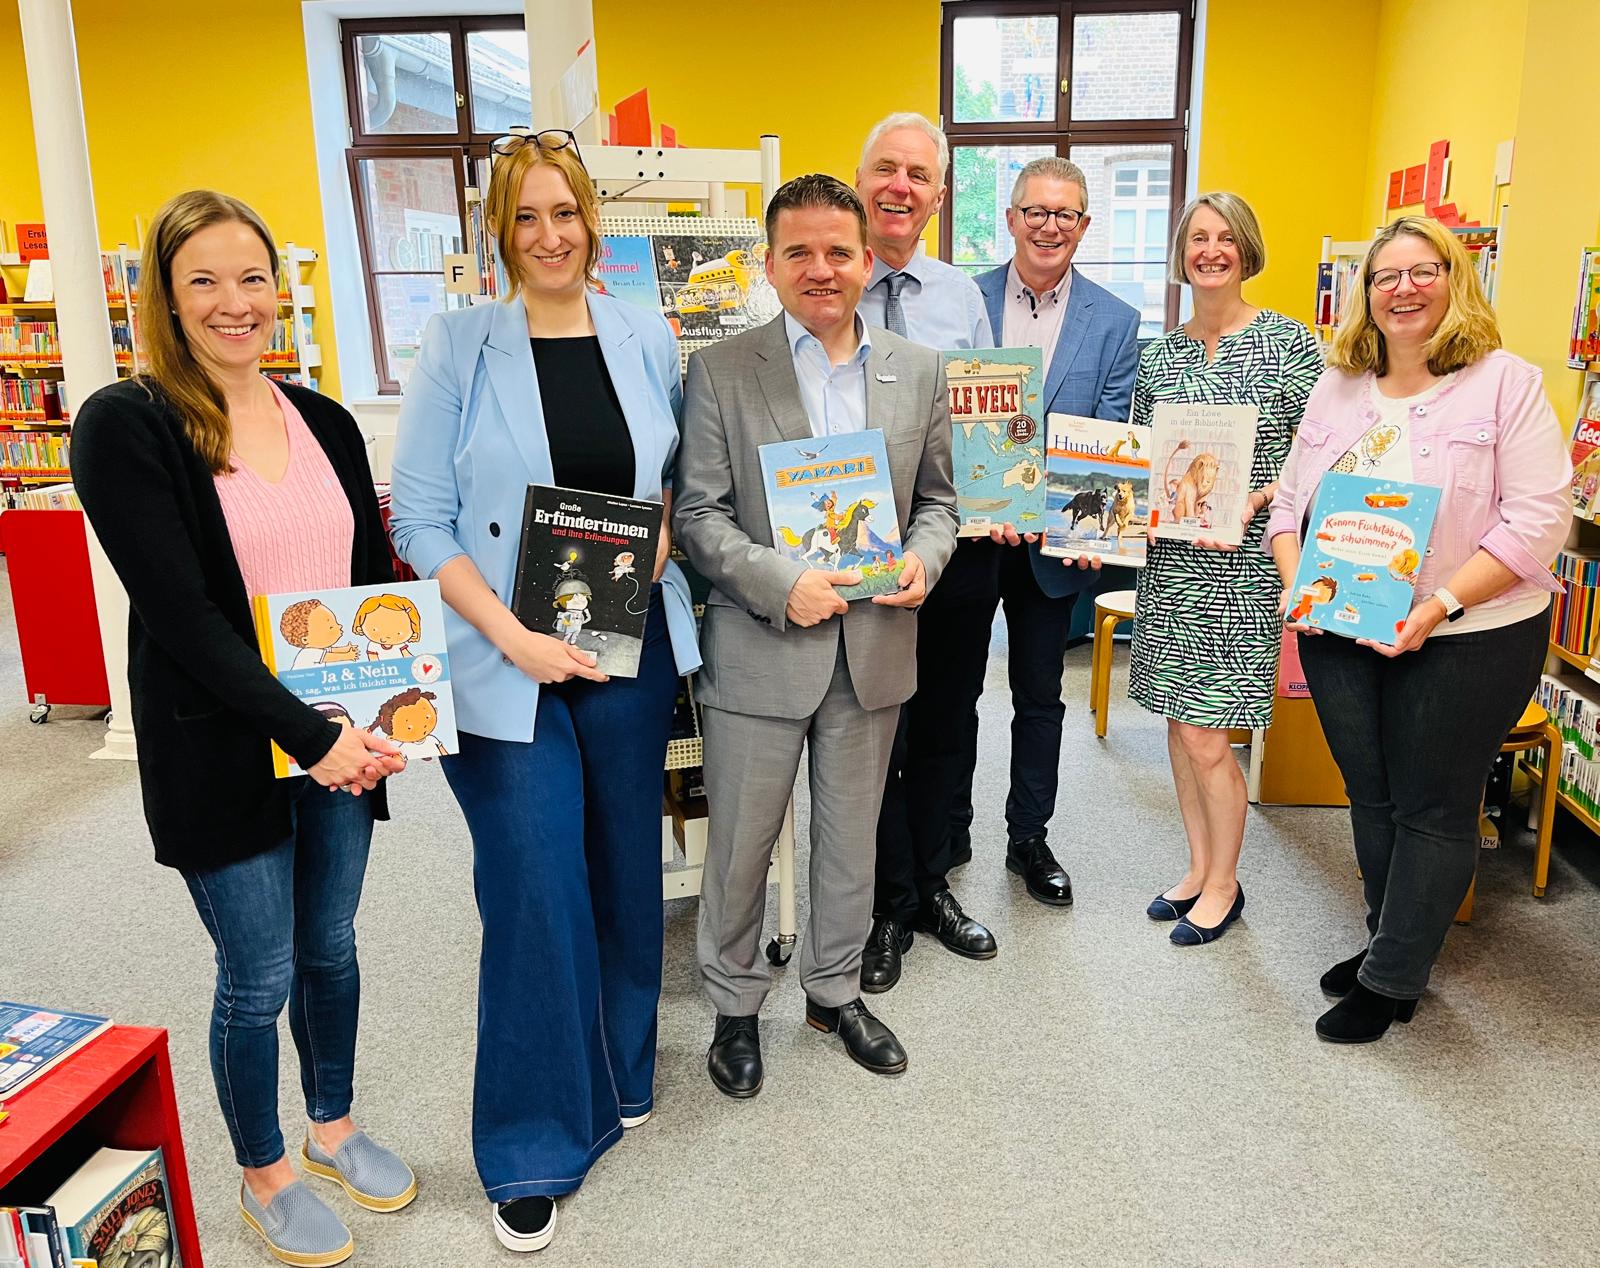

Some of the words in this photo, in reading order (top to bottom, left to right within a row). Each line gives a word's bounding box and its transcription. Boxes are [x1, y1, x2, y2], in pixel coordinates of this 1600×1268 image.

[452, 265, 464, 283] F
[681, 326, 723, 339] Ausflug
[948, 386, 973, 415] LE
[976, 384, 1018, 414] WELT
[1186, 408, 1199, 417] Ein
[1015, 420, 1027, 429] 20
[1180, 418, 1193, 426] der
[1054, 434, 1110, 457] Hunde
[560, 502, 581, 513] Große
[534, 508, 649, 539] Erfinderinnen
[552, 527, 566, 537] und
[585, 531, 629, 546] Erfindungen
[1340, 532, 1398, 550] schwimmen?
[321, 670, 338, 685] Ja
[341, 667, 356, 681] &
[359, 663, 399, 679] Nein
[305, 686, 321, 697] sag,
[324, 684, 340, 693] was
[343, 682, 357, 691] ich
[359, 678, 387, 689] (nicht)
[389, 676, 407, 686] mag
[125, 1181, 158, 1210] JONES
